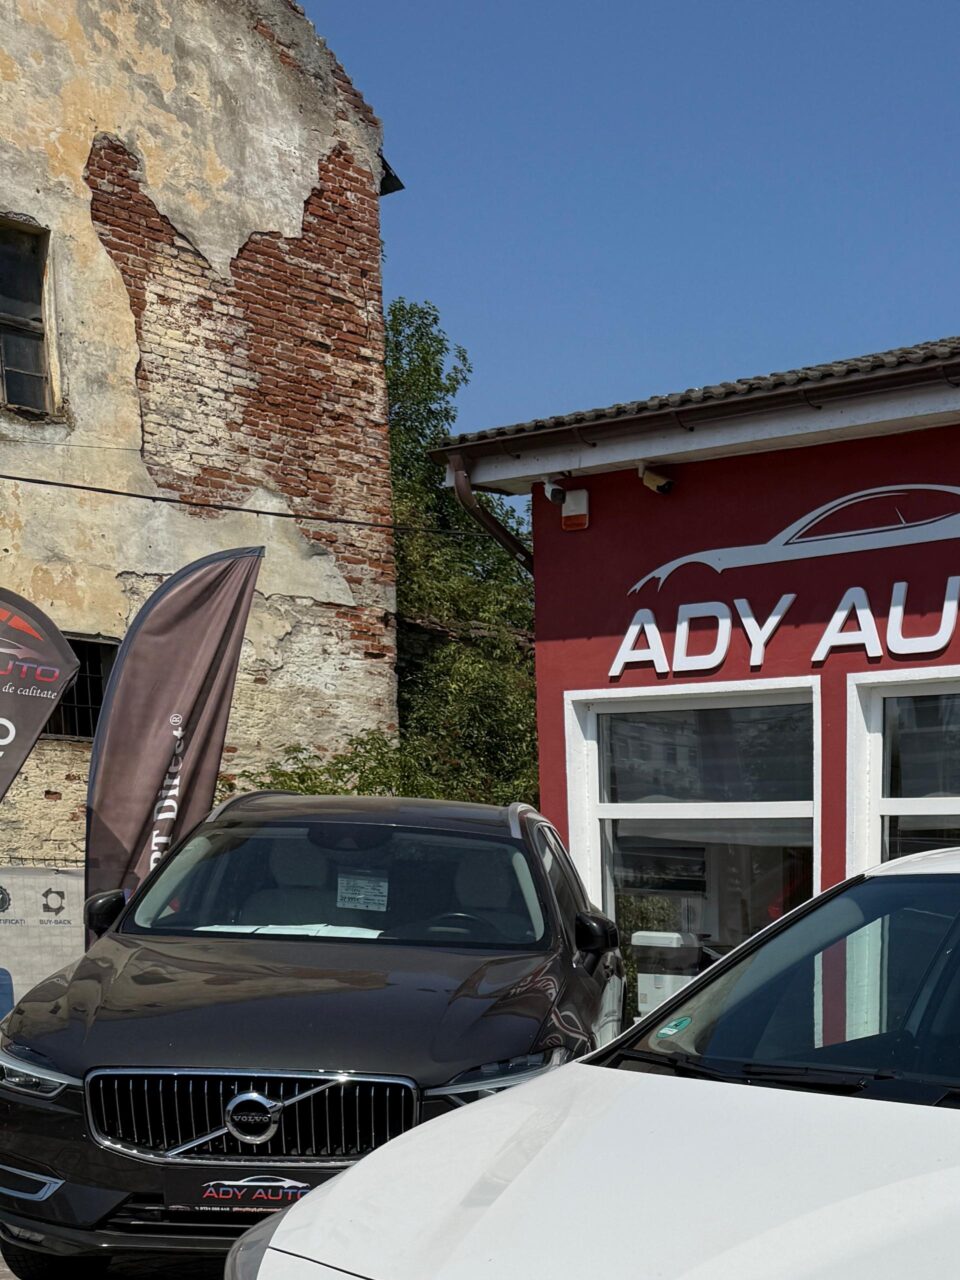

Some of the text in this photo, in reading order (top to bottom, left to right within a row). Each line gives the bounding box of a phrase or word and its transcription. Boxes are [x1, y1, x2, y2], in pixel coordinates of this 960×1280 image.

[608, 594, 798, 678] ADY
[2, 682, 58, 700] de calitate
[39, 918, 72, 926] BUY-BACK
[203, 1187, 248, 1200] ADY
